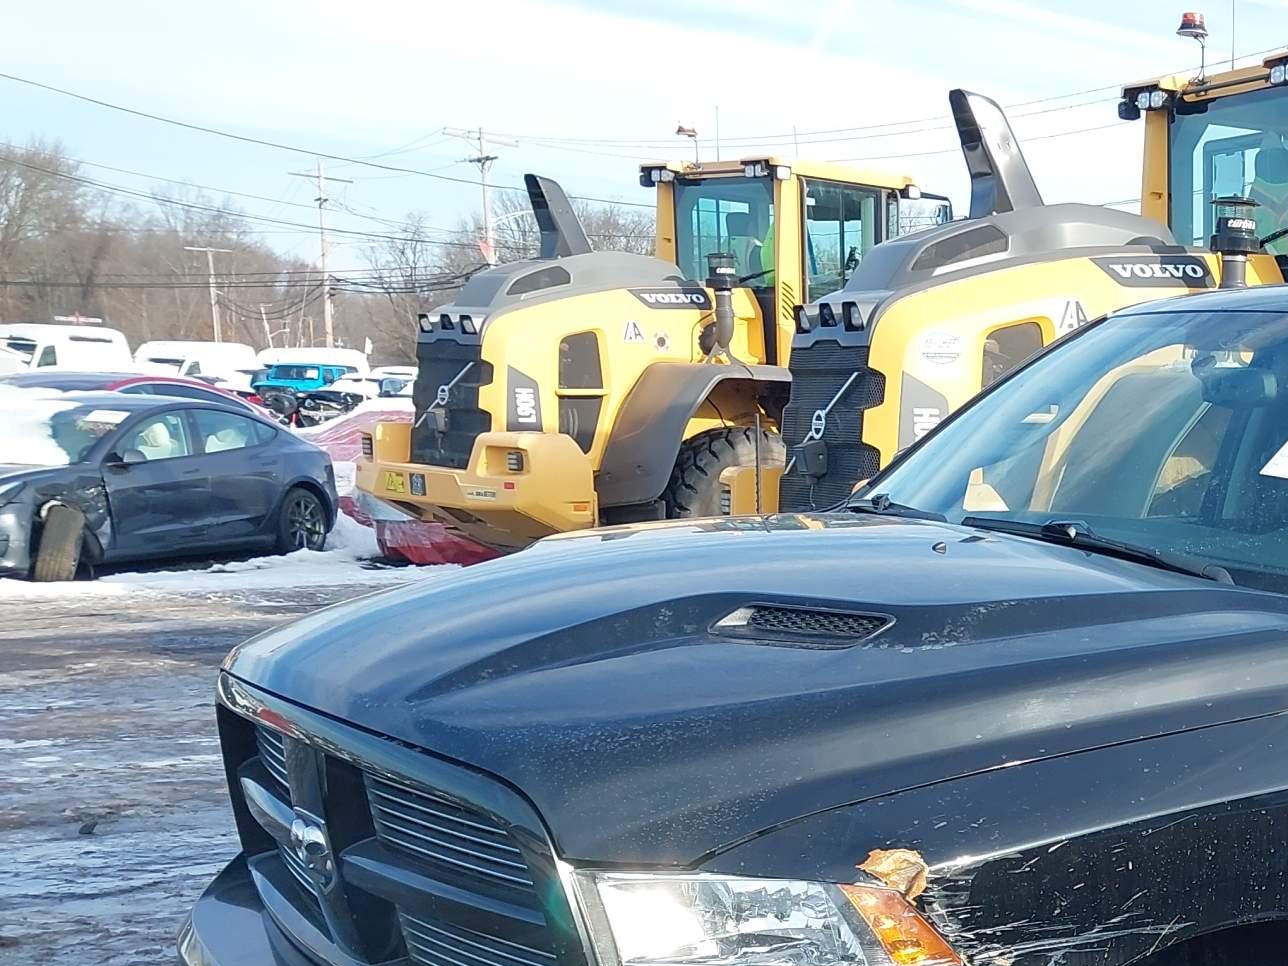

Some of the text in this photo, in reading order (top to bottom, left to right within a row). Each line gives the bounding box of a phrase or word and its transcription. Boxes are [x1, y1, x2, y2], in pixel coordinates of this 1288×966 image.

[1109, 264, 1204, 279] VOLVO
[639, 293, 705, 304] VOLVO
[513, 387, 537, 423] L90H
